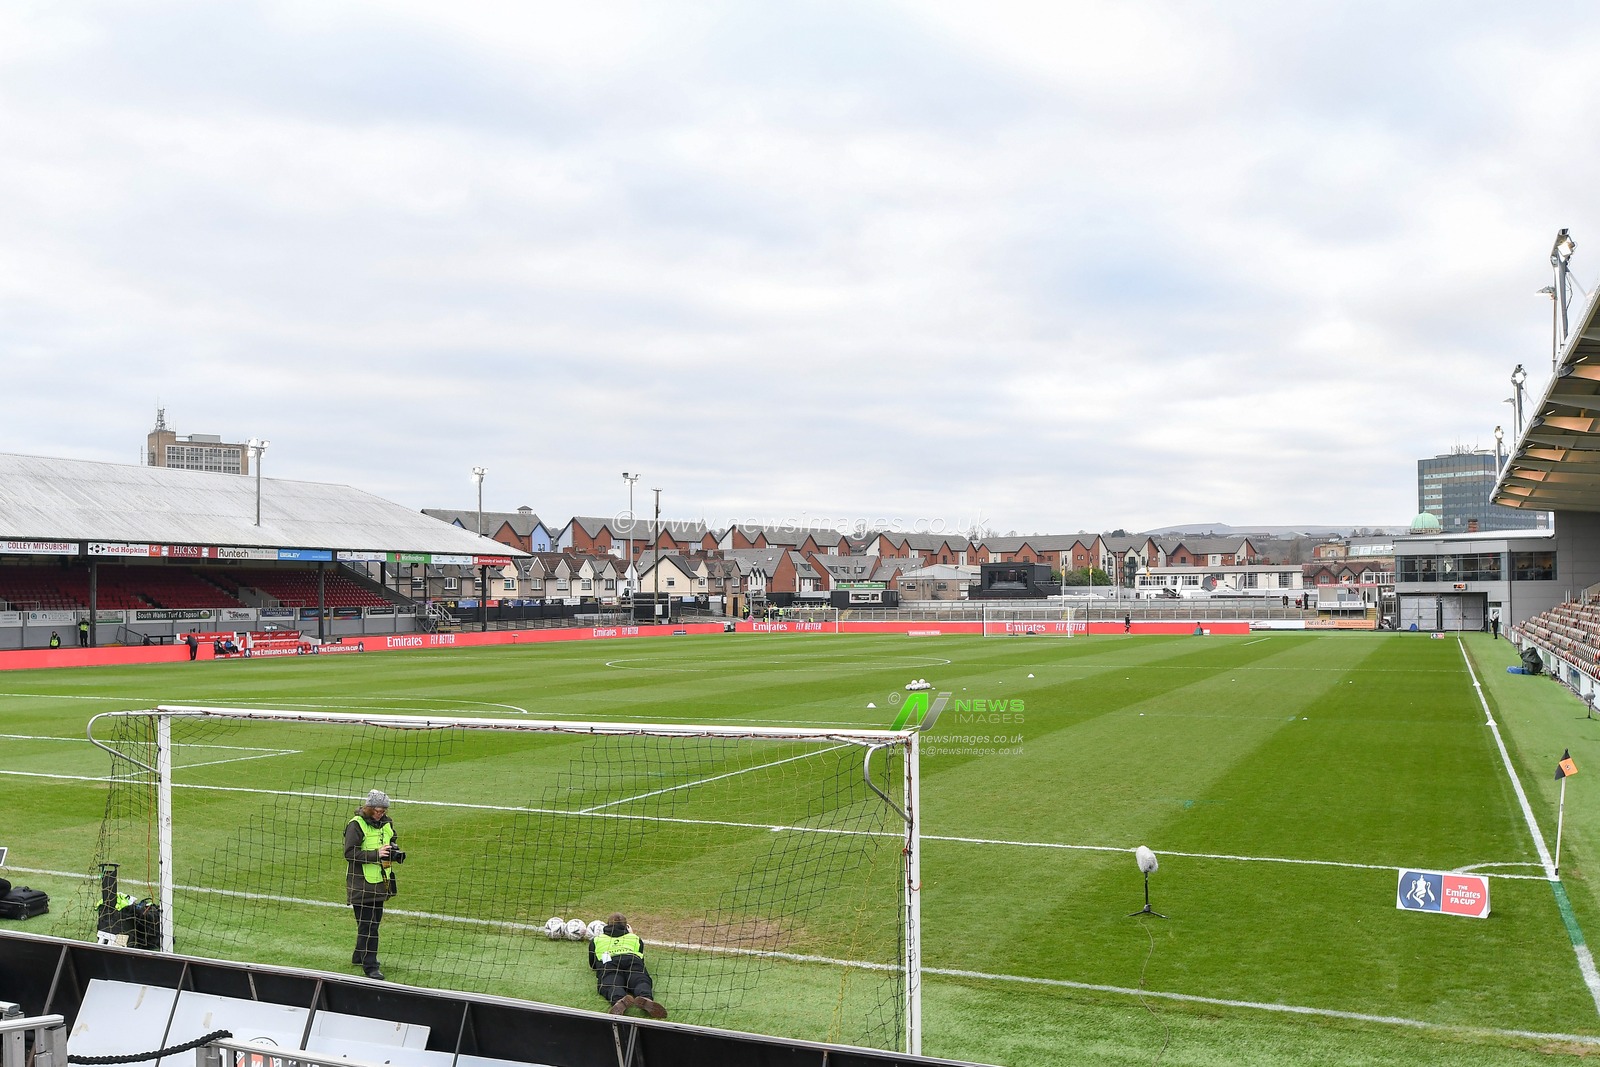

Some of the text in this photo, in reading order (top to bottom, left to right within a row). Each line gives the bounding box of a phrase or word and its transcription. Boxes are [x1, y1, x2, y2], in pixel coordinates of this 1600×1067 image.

[7, 541, 70, 551] COLLEY MITSUBISHI
[121, 546, 148, 554] Hopkins
[173, 545, 198, 555] HICKS
[218, 548, 249, 558] Runtech
[137, 611, 152, 619] South
[153, 611, 167, 619] Wales
[183, 611, 200, 619] Topsoil
[753, 622, 822, 631] Emirates FLY BETTER
[1005, 622, 1046, 632] Emirates
[1055, 623, 1066, 631] FLY
[592, 628, 617, 637] Emirates
[387, 634, 455, 648] Emirates FLY BETTER
[261, 648, 282, 656] Emirates
[327, 645, 345, 653] Emirates
[1445, 888, 1481, 899] Emirates
[1460, 898, 1476, 906] CUP
